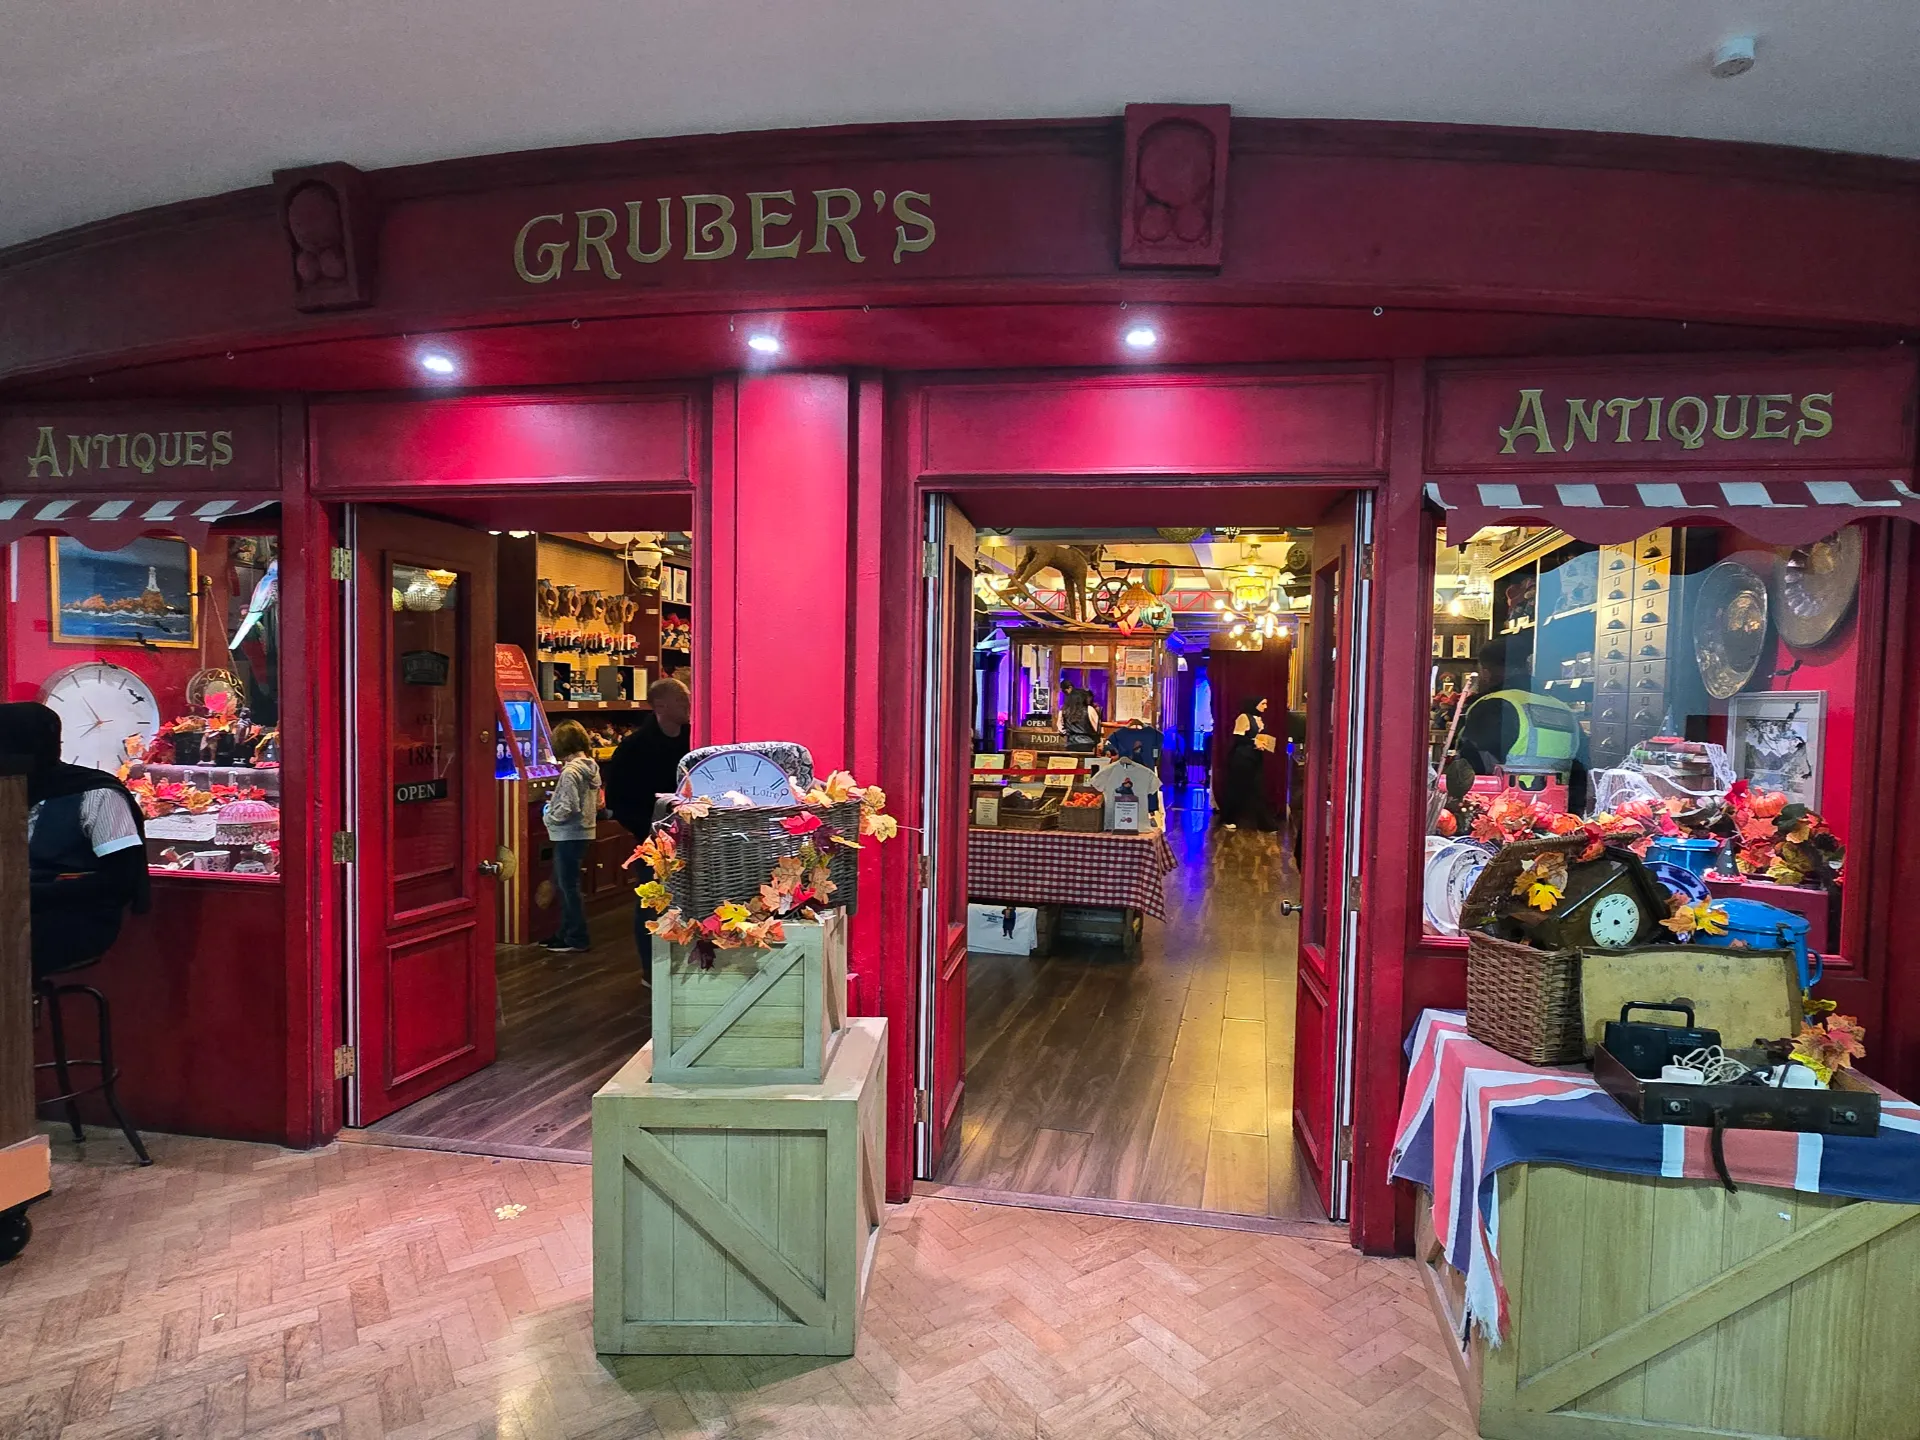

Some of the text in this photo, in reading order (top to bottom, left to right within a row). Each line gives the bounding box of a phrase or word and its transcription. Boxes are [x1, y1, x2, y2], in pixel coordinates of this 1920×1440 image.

[513, 187, 936, 284] GRUBER'S
[1499, 389, 1834, 454] ANTIQUES
[27, 426, 233, 477] ANTIQUES
[408, 745, 442, 766] 1887
[396, 783, 436, 802] OPEN
